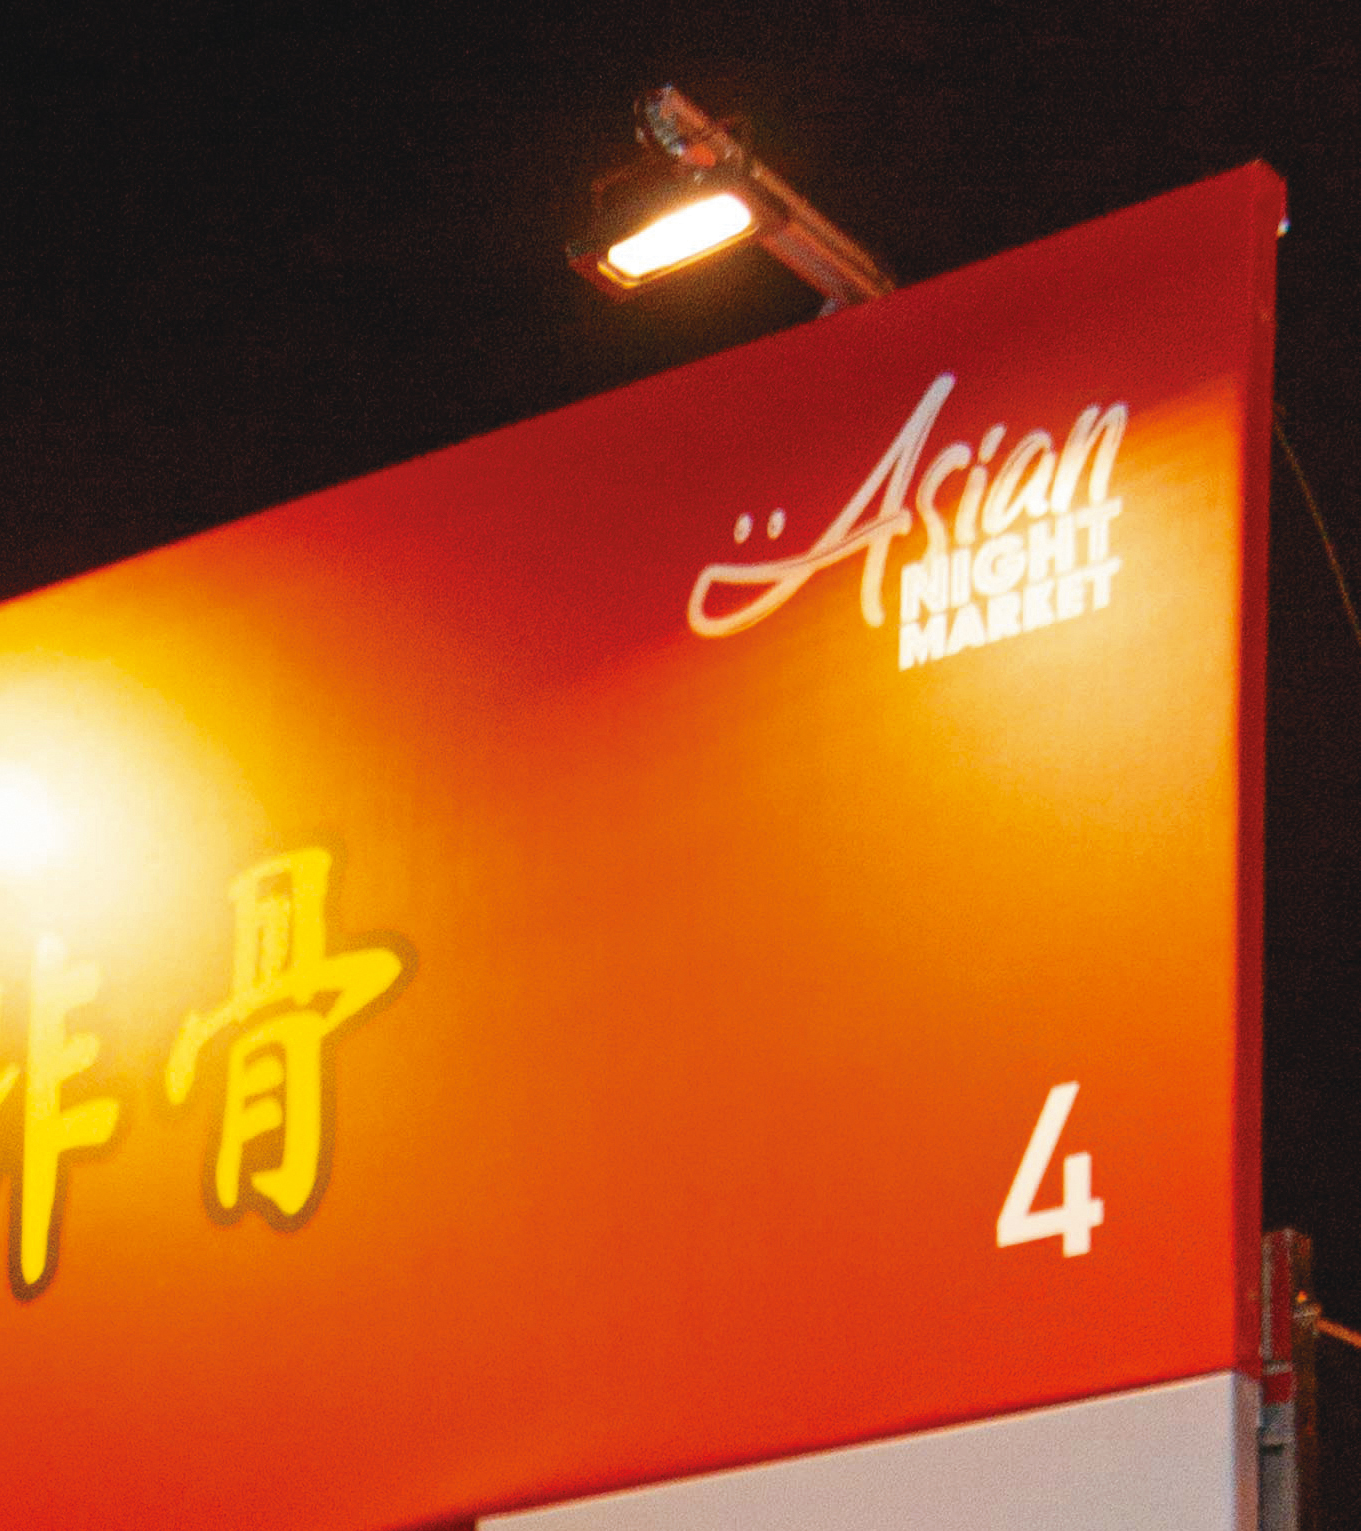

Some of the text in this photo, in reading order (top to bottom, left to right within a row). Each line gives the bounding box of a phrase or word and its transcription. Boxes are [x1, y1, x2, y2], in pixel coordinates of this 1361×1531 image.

[689, 373, 1128, 637] Asian
[900, 499, 1123, 618] NIGHT
[898, 558, 1123, 672] MARKET
[995, 1080, 1104, 1257] 4
